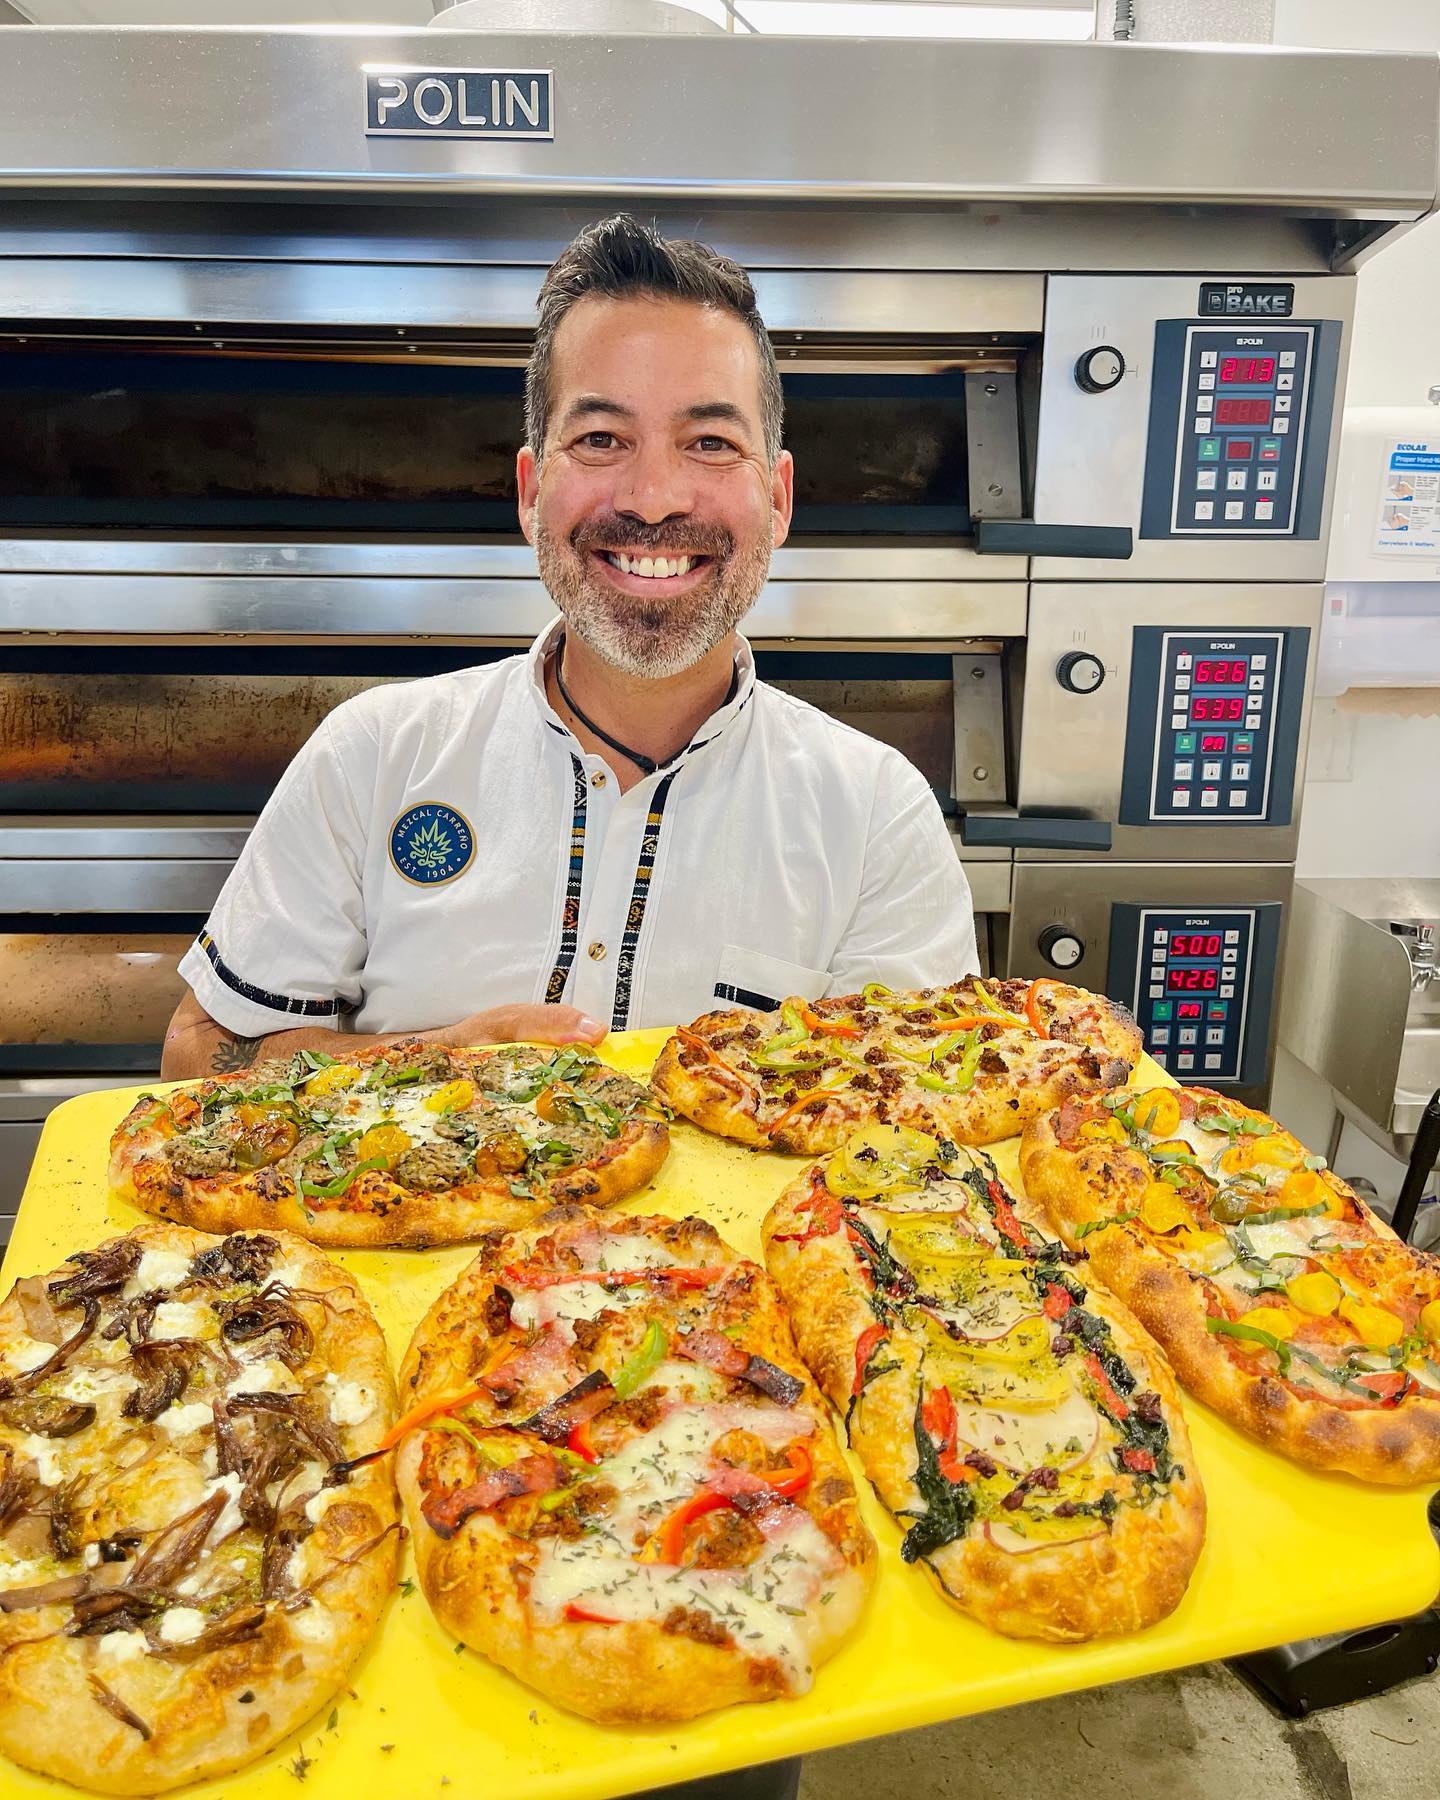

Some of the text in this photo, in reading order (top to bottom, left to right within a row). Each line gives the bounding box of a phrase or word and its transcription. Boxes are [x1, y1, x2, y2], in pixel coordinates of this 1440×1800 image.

[377, 77, 540, 127] POLIN
[1227, 286, 1243, 295] pro
[1226, 295, 1287, 313] BAKE
[1221, 359, 1275, 381] 213
[1196, 661, 1246, 682] 626
[1193, 698, 1243, 719] 539
[397, 809, 469, 850] MEZCAL CARREÑO
[427, 865, 454, 879] 1904
[1171, 970, 1216, 988] 426
